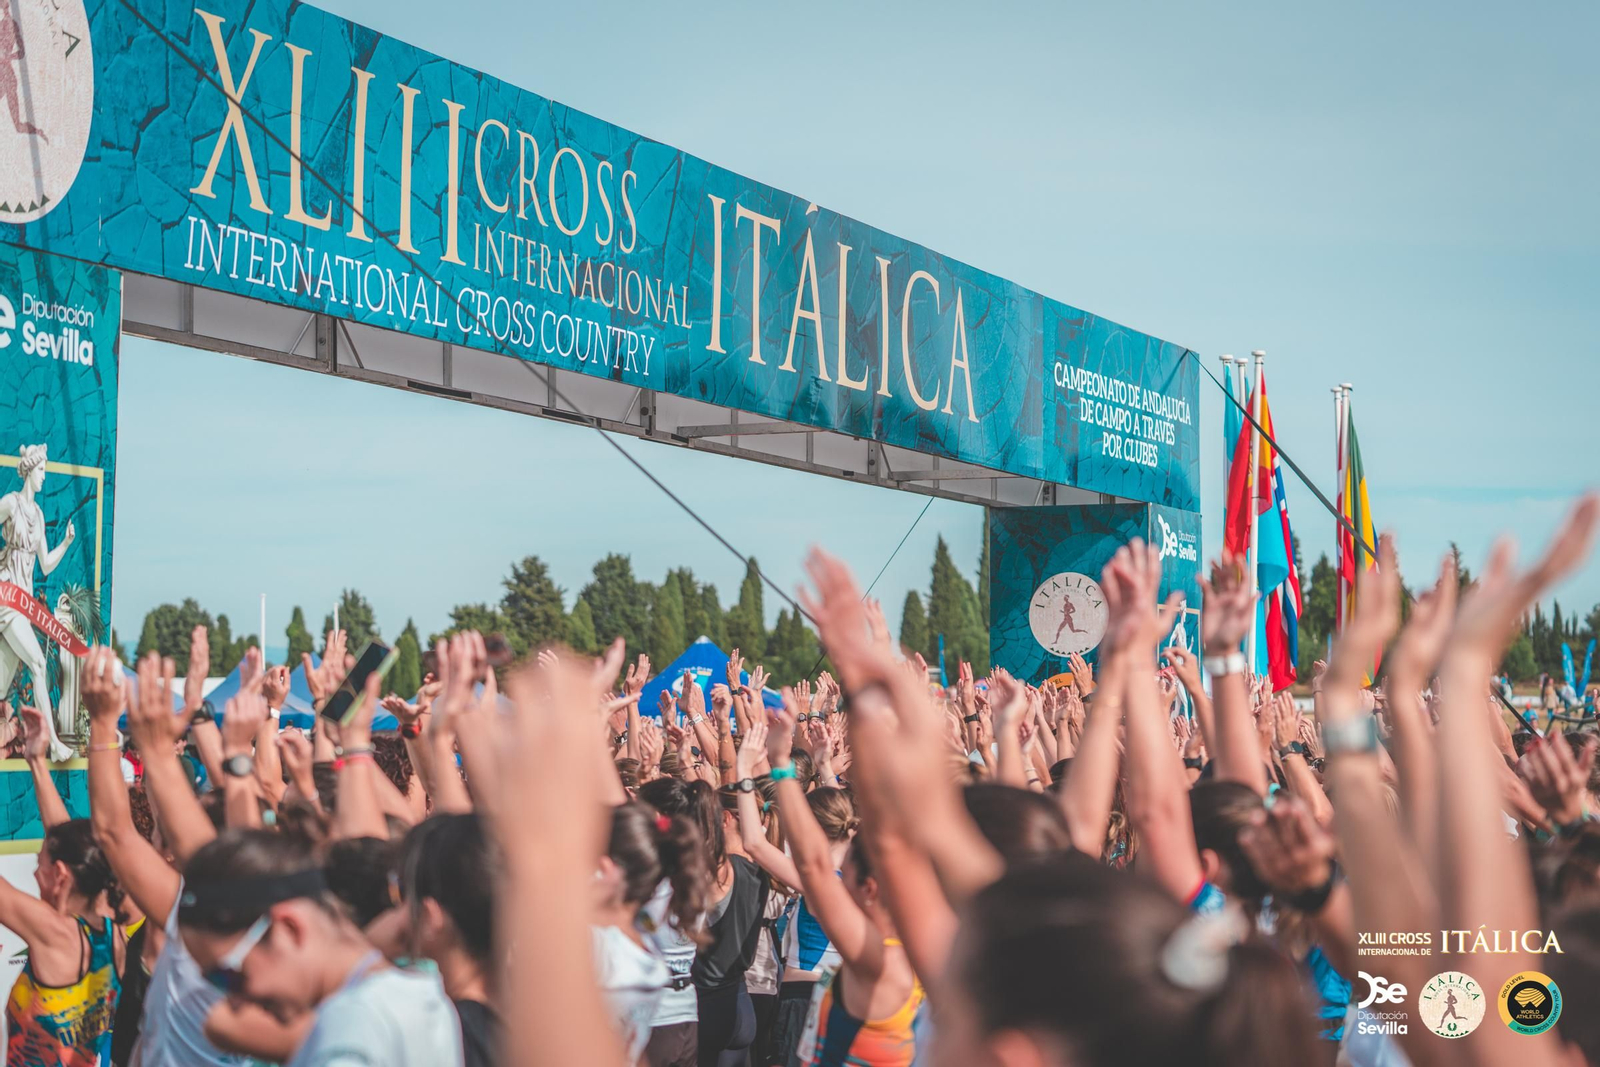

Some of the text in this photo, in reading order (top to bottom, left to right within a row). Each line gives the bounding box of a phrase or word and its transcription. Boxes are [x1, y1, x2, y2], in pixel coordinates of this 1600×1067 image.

[190, 8, 637, 266] XLIII CROSS
[184, 216, 655, 375] INTERNATIONAL CROSS COUNTRY
[473, 222, 692, 329] INTERNACIONAL
[22, 292, 94, 328] Diputación
[706, 194, 980, 423] ITÁLICA
[22, 320, 94, 366] Sevilla
[1054, 362, 1191, 426] CAMPEONATO DE ANDALUCÍA
[1080, 397, 1175, 446] DE CAMPO A TRAVÉS
[1102, 431, 1158, 468] POR CLUBES
[20, 592, 35, 616] DE
[36, 609, 72, 649] ITÁLICA
[1035, 576, 1103, 609] ITÁLICA
